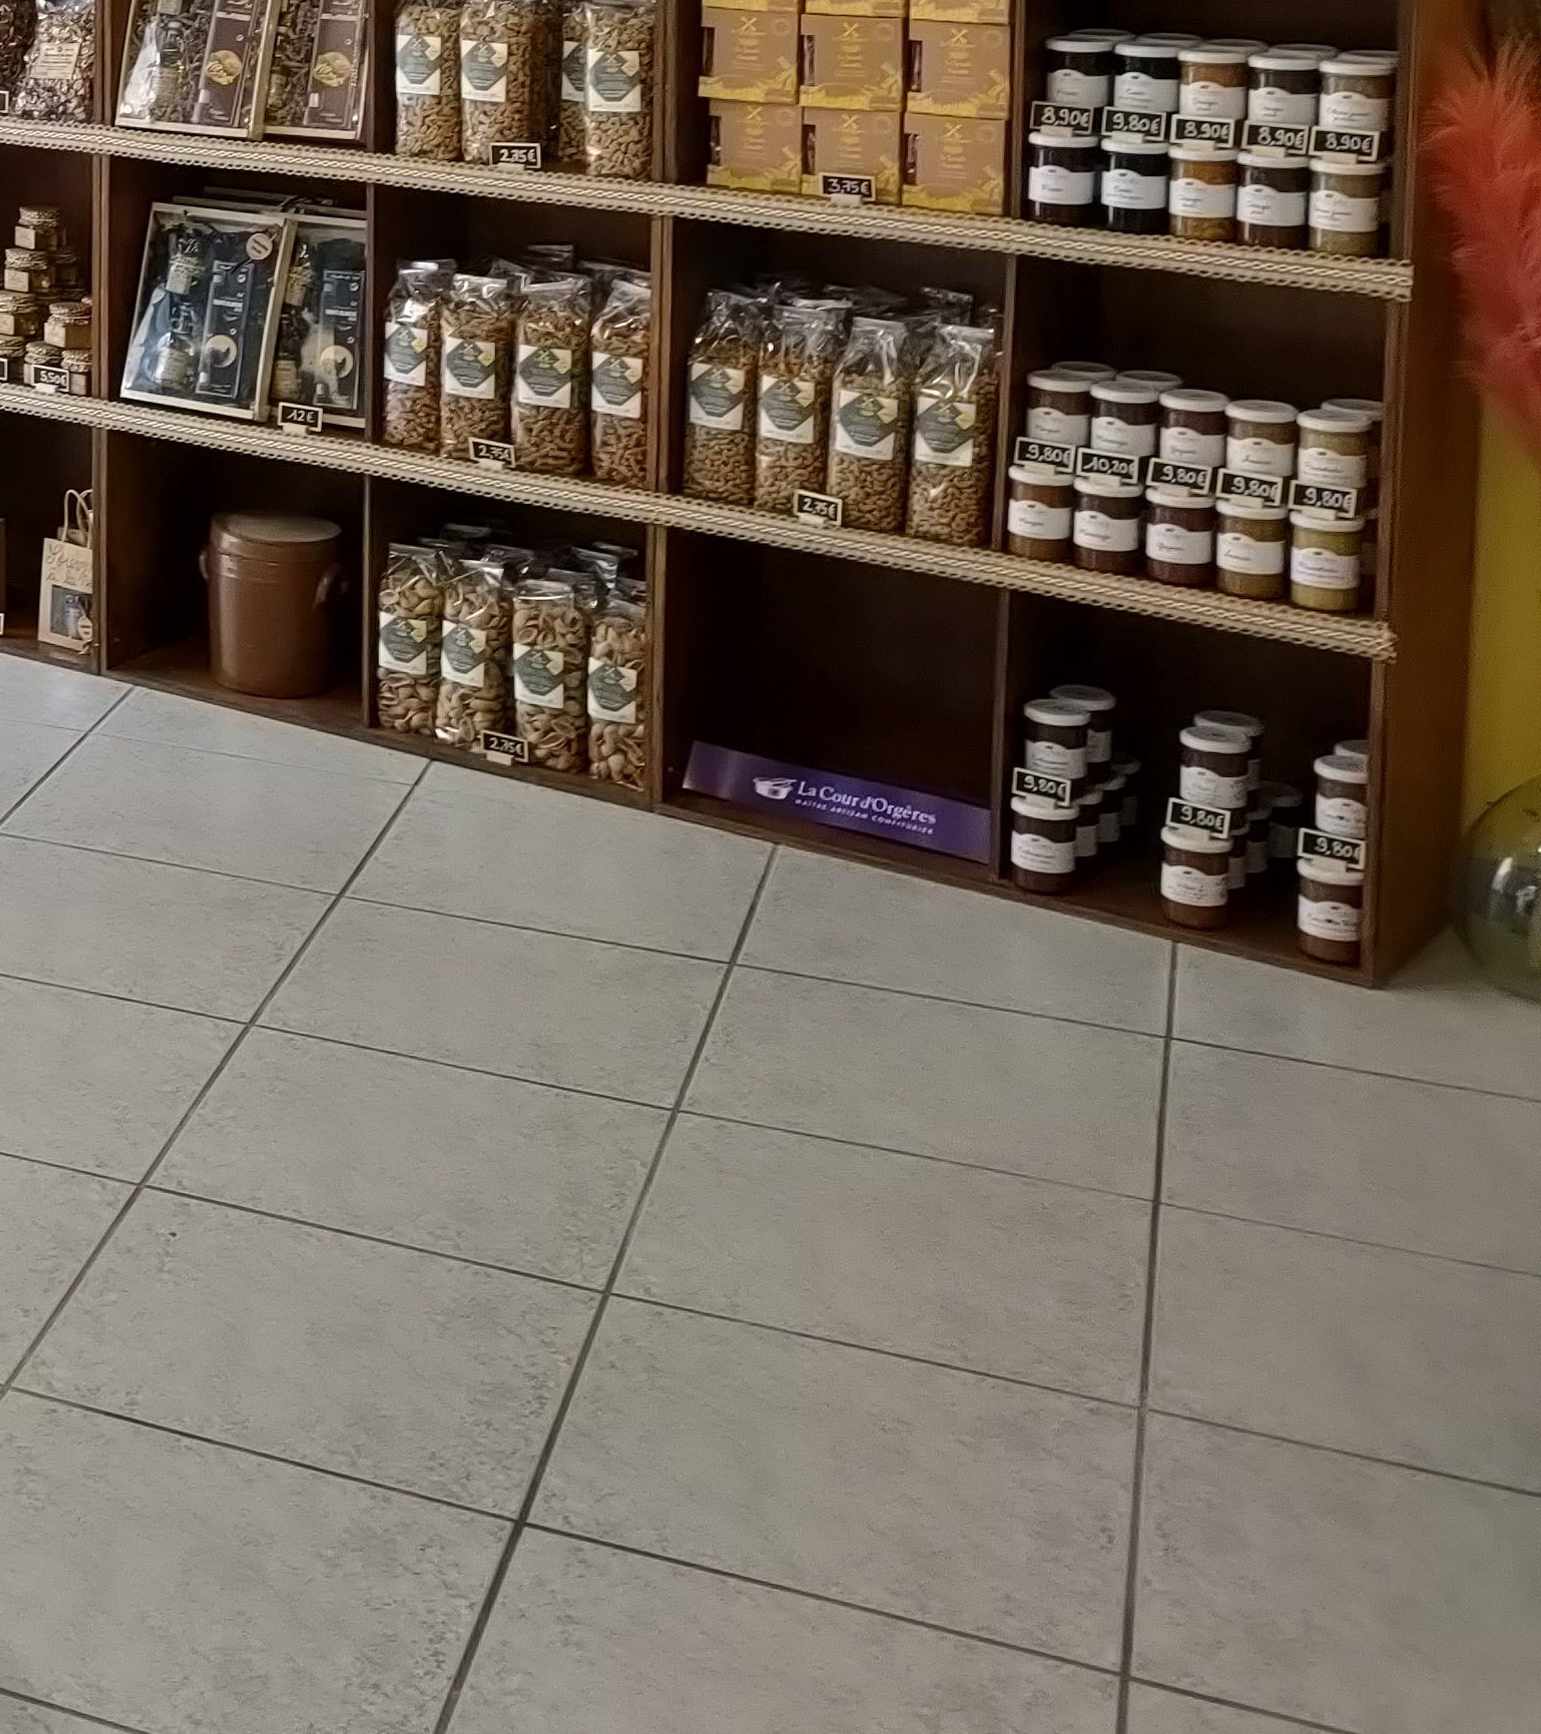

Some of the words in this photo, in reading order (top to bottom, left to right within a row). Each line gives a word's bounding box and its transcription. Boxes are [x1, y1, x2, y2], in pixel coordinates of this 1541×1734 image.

[1042, 107, 1089, 127] 8,90€
[1112, 112, 1160, 132] 9,80€
[1185, 120, 1230, 140] 8,90€
[1258, 127, 1304, 148] 8,90€
[1325, 133, 1373, 151] 8,90€
[498, 147, 536, 163] 2,75€
[828, 179, 870, 195] 3,75€
[289, 410, 314, 424] 12€
[1027, 444, 1071, 464] 9,80€
[1083, 456, 1135, 476] 10,20€
[1163, 466, 1208, 486] 9,80€
[1231, 477, 1279, 498] 9,80€
[802, 496, 835, 518] 2,75€
[1305, 488, 1352, 509] 9,80€
[1024, 775, 1066, 795] 9,80€
[798, 781, 816, 797] La
[819, 787, 859, 807] Cour
[860, 796, 936, 824] d'Orgères
[1181, 807, 1225, 830] 9,80€
[1315, 837, 1360, 859] 9,80€
